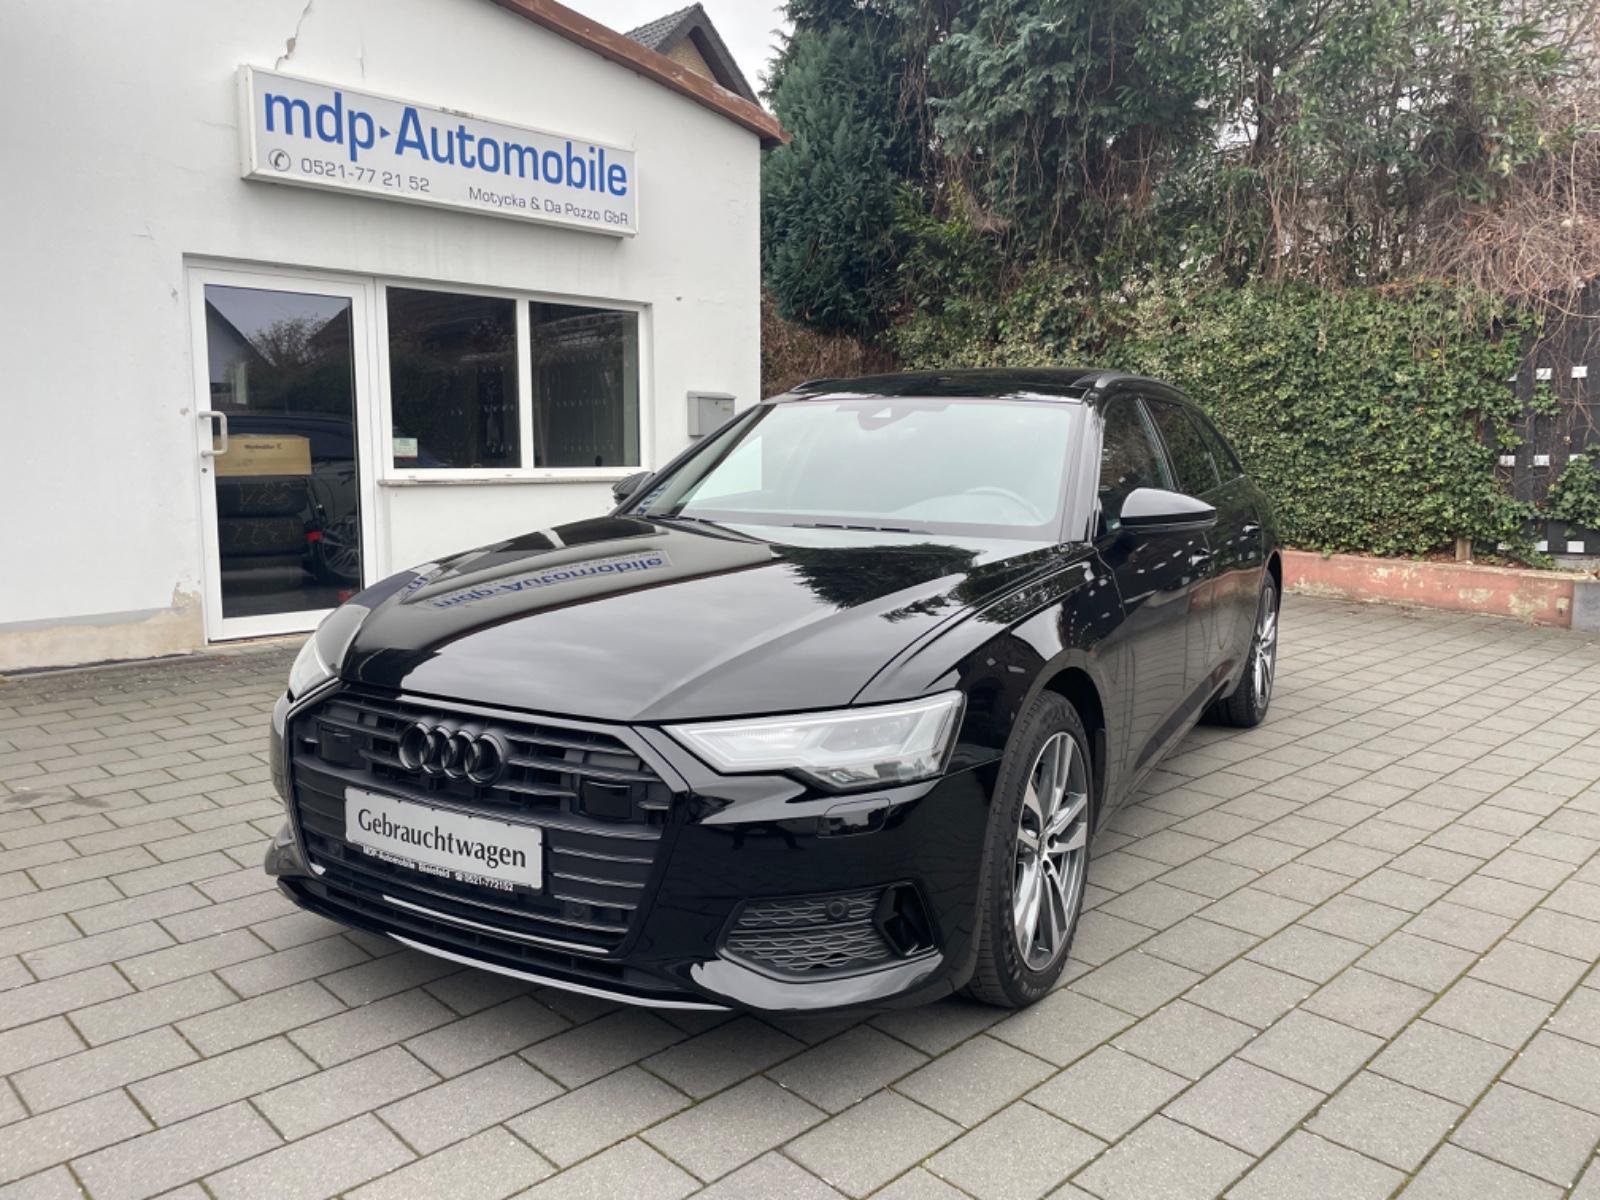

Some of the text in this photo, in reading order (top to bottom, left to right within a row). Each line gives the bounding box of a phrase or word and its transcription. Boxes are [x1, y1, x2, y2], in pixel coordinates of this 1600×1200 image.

[301, 158, 430, 193] 0521-77 21 52
[394, 105, 628, 197] Automobile
[469, 186, 628, 225] Motycka & Da Pozzo GbR
[358, 808, 526, 869] Gebrauchtwagen
